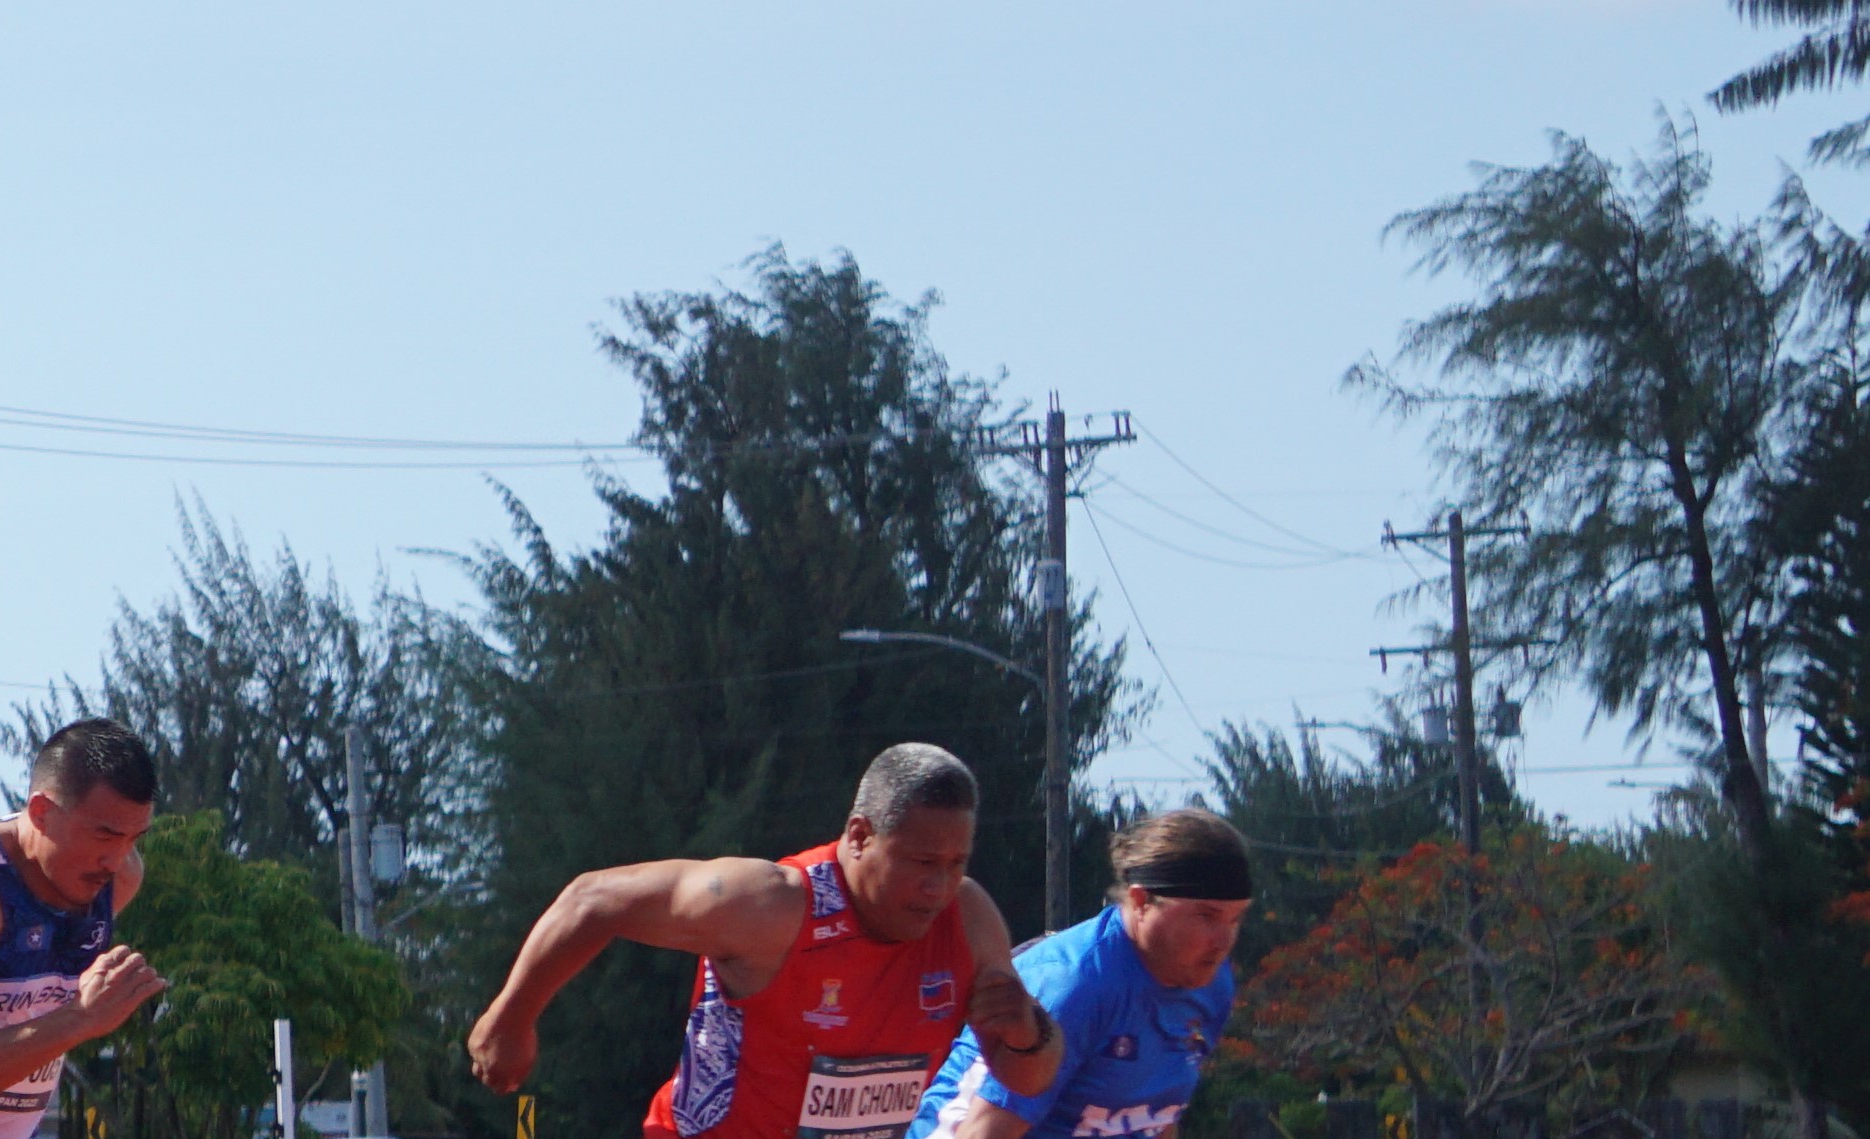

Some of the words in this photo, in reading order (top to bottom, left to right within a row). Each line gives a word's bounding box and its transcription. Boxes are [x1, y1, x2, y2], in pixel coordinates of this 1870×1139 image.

[813, 921, 850, 940] BLK
[808, 1085, 856, 1117] SAM
[858, 1081, 920, 1116] CHONG
